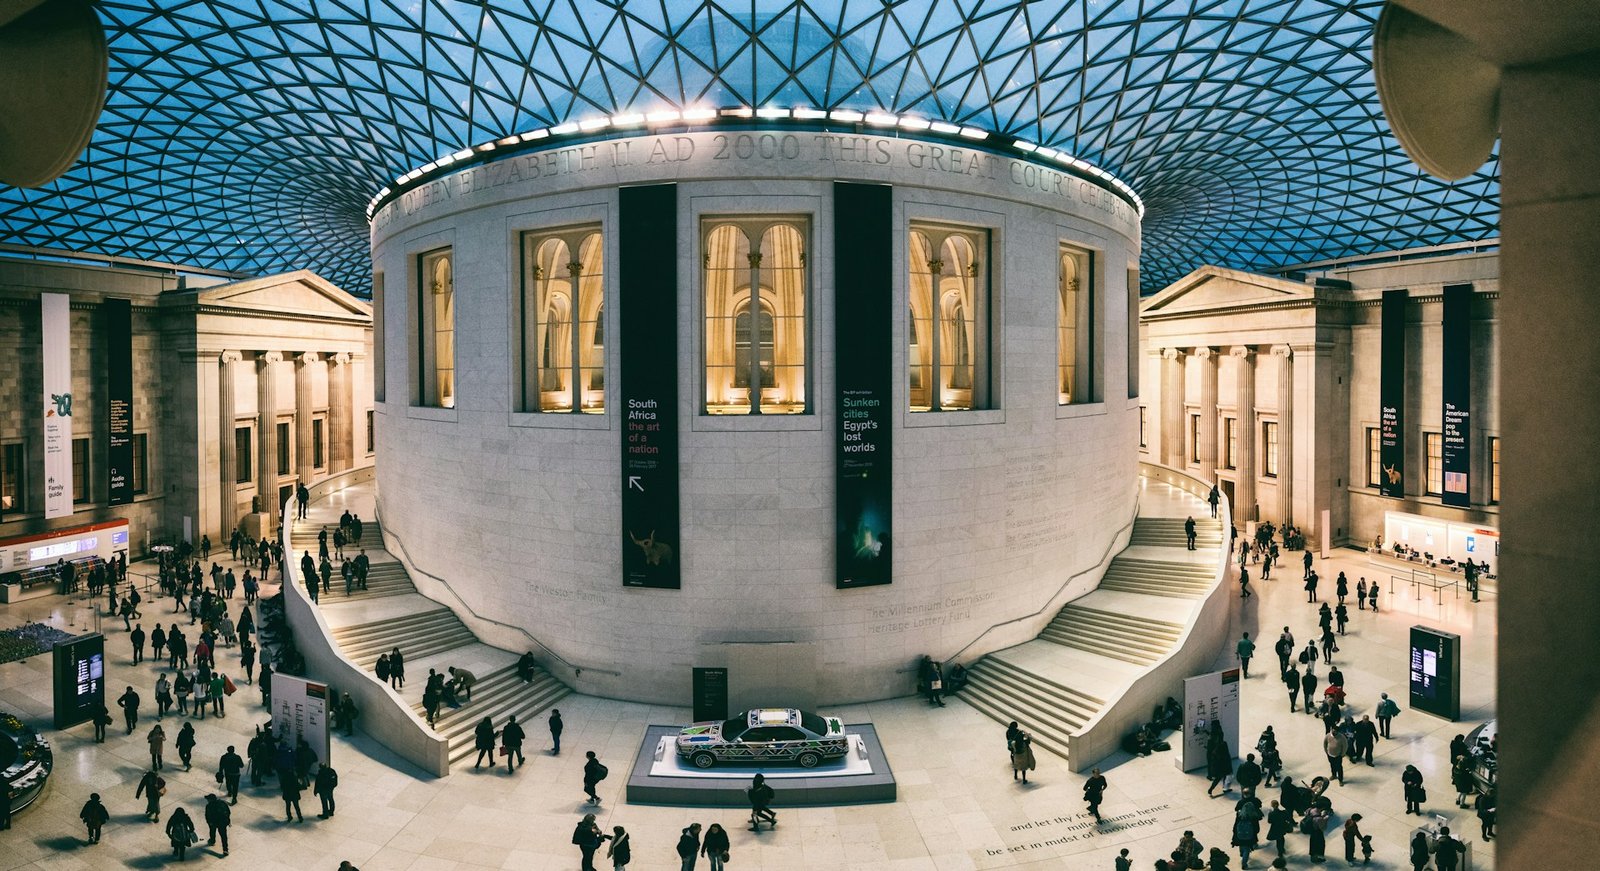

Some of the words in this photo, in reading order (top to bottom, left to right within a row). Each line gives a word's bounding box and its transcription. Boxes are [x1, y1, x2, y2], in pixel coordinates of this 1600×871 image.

[405, 177, 453, 217] QUEEN
[460, 145, 599, 196] ELIZABETH
[611, 141, 633, 167] II
[646, 136, 696, 164] AD
[712, 134, 801, 161] 2000
[814, 135, 892, 165] THIS
[906, 143, 1001, 180] GREAT
[1009, 161, 1074, 199] COURT
[628, 399, 657, 409] South
[843, 398, 880, 407] Sunken
[628, 410, 656, 420] Africa
[843, 409, 869, 418] cities
[628, 422, 644, 431] the
[646, 422, 660, 431] art
[843, 419, 878, 432] Egypt's
[628, 433, 639, 442] of
[843, 431, 862, 442] lost
[628, 444, 659, 454] nation
[843, 442, 876, 453] worlds
[48, 491, 62, 499] guide
[866, 606, 885, 618] The
[887, 601, 942, 616] Millennium
[945, 591, 995, 608] Commission
[867, 622, 910, 634] Heritage
[913, 615, 946, 628] Lottery
[949, 609, 970, 621] Fund
[1136, 803, 1172, 816] hence
[1010, 822, 1033, 832] and
[1034, 819, 1052, 827] let
[1054, 816, 1073, 824] thy
[1075, 811, 1096, 820] fee
[986, 848, 1003, 856] be
[1007, 844, 1028, 853] set
[1045, 835, 1080, 846] midst
[1082, 831, 1095, 839] of
[1097, 817, 1159, 836] knowledge
